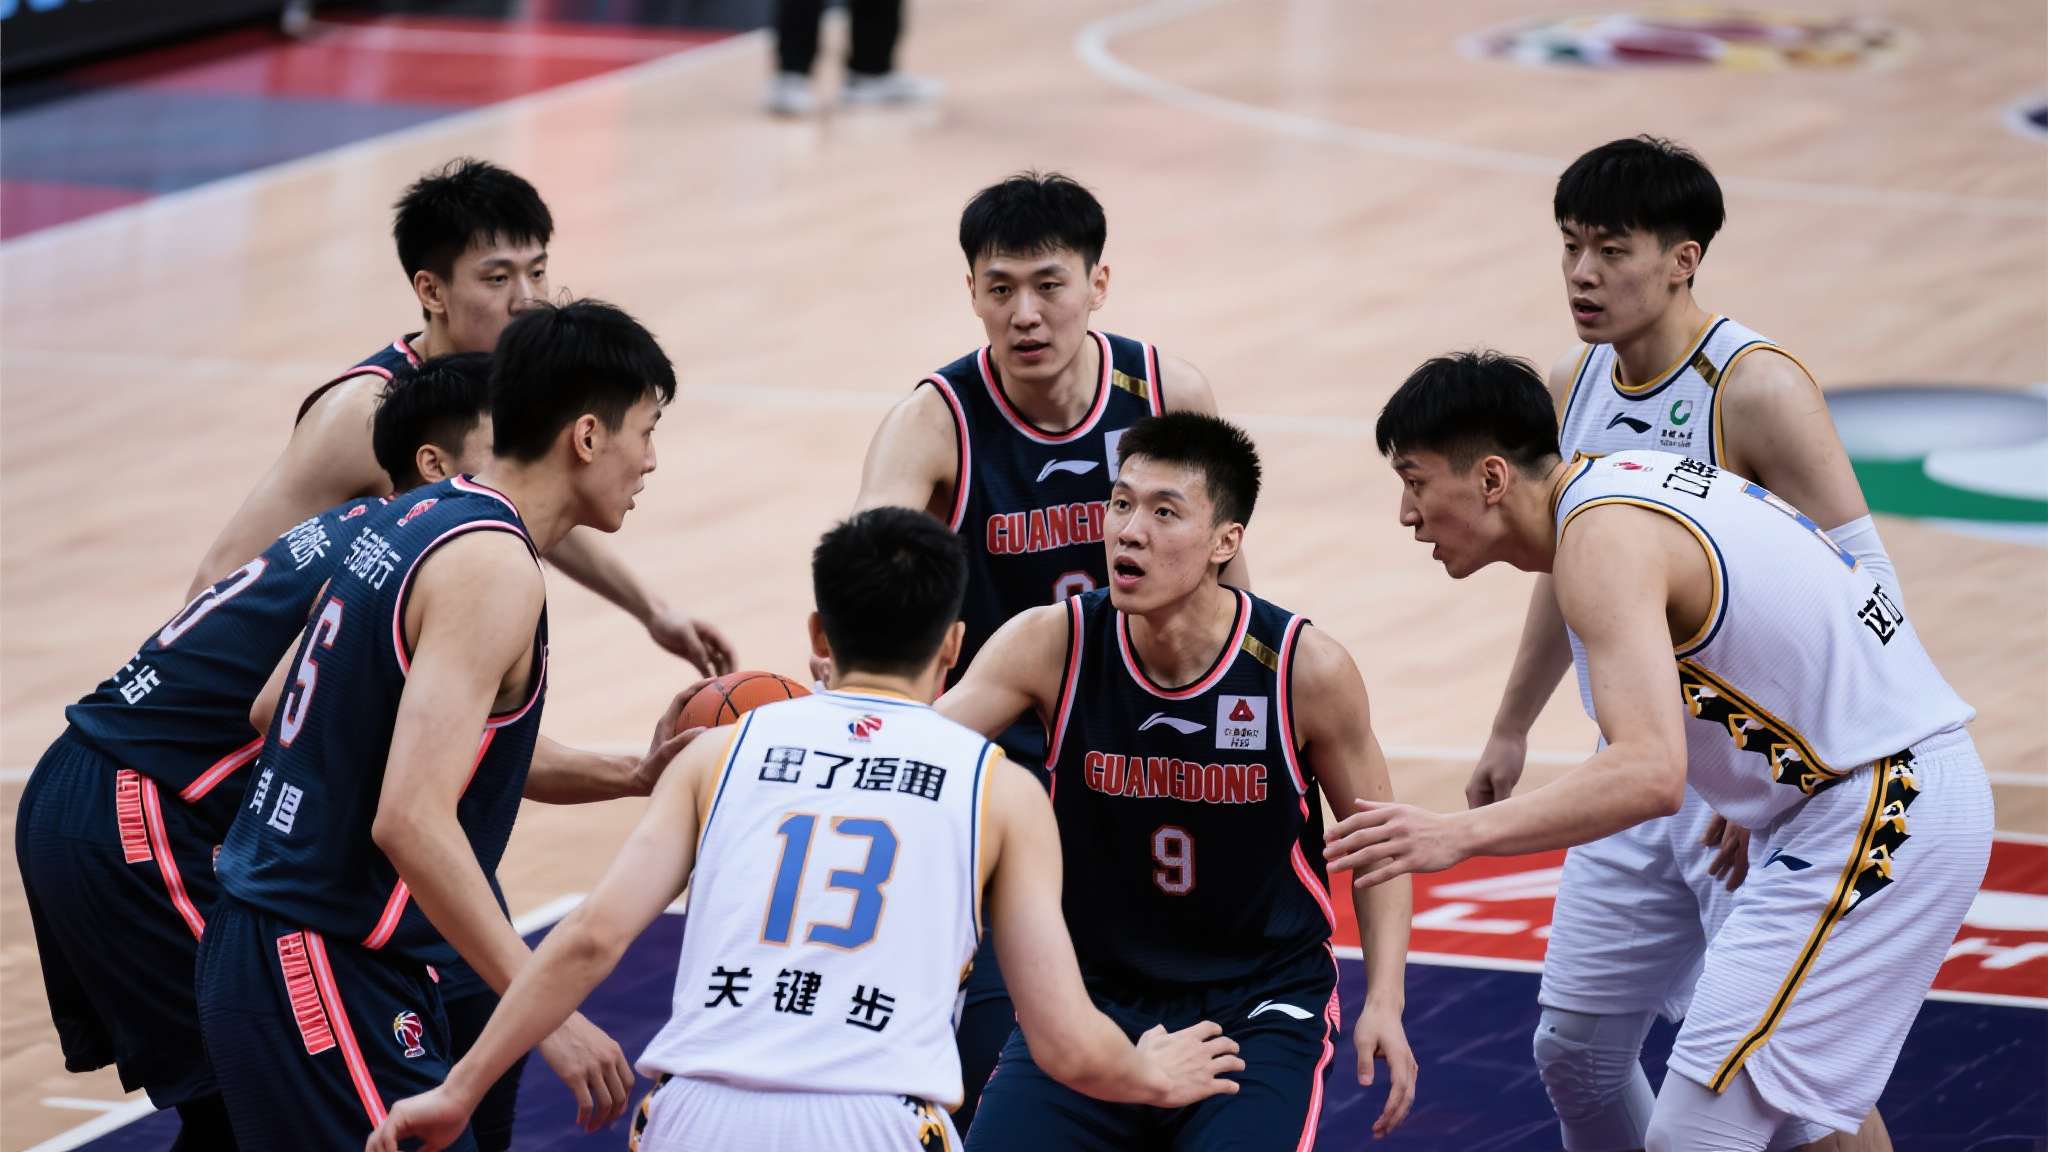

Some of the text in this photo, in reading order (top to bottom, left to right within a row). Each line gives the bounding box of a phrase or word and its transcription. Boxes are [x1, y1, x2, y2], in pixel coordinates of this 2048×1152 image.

[986, 500, 1109, 555] GUANGD
[1084, 750, 1268, 804] GUANGDONG
[759, 811, 901, 954] 13
[1151, 823, 1199, 896] 9
[704, 966, 896, 1033] 关键步
